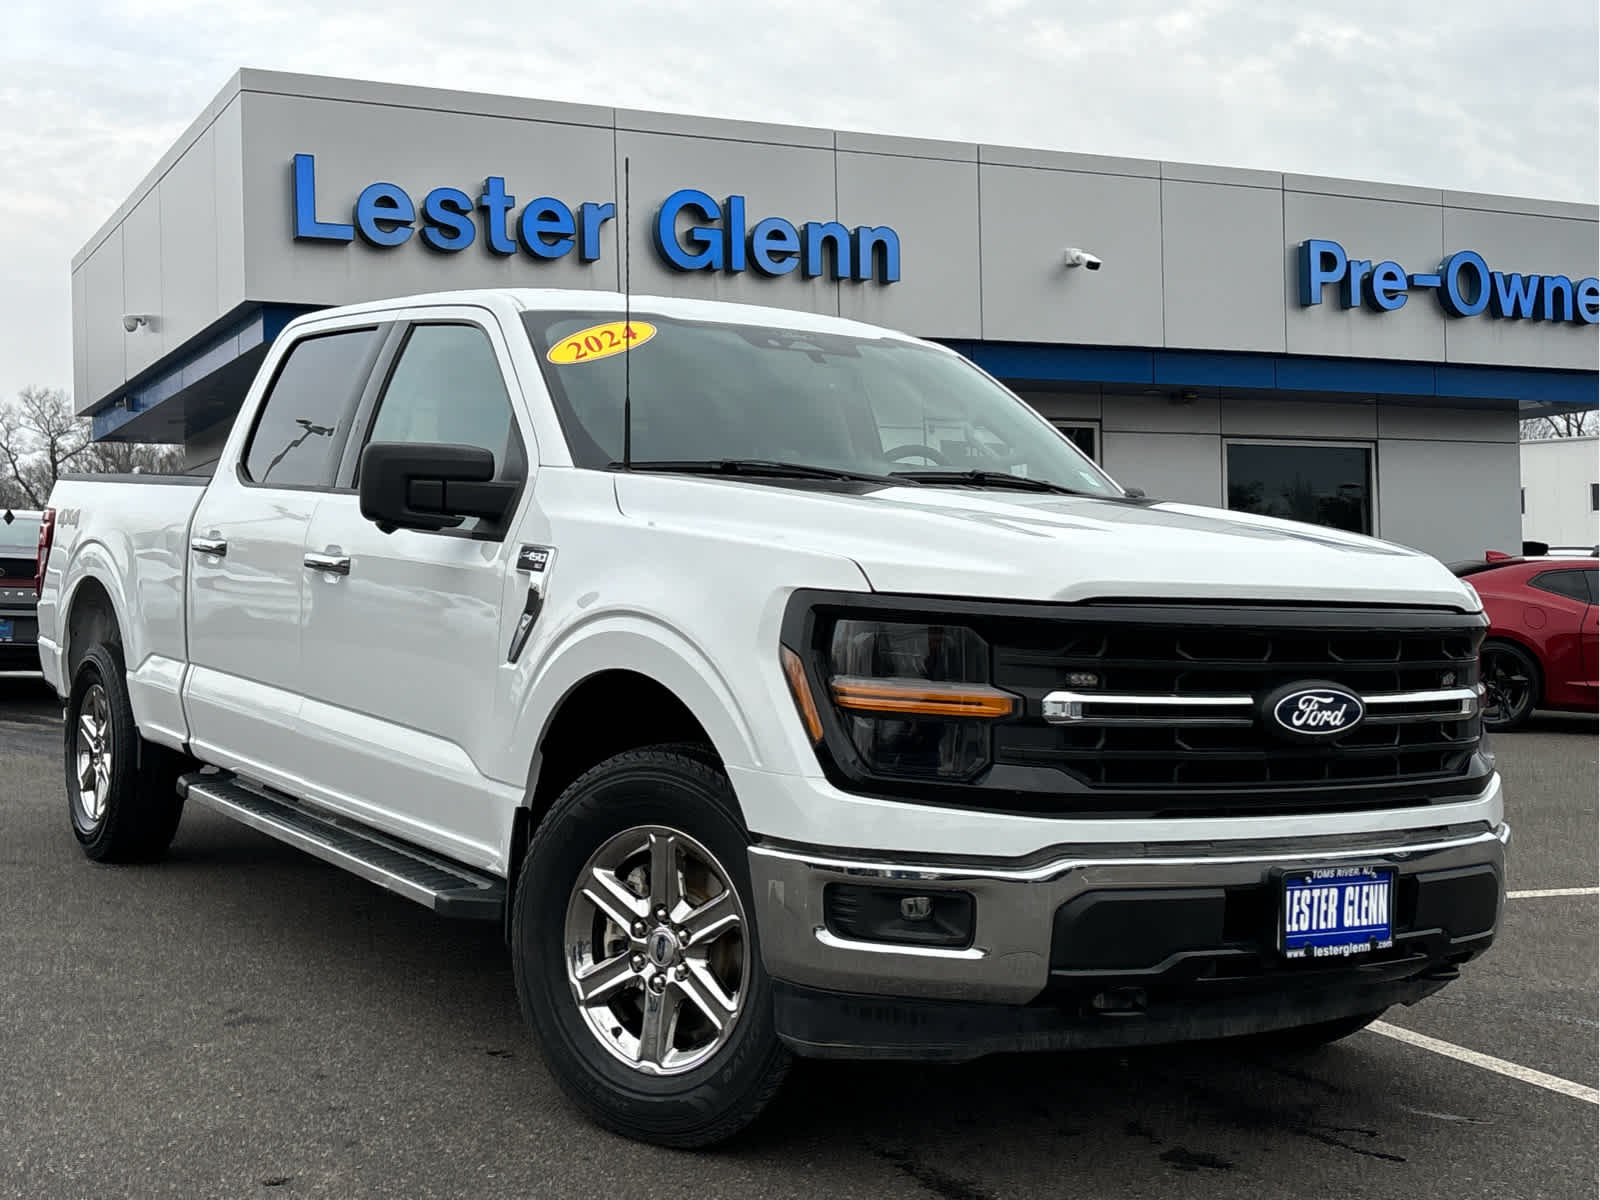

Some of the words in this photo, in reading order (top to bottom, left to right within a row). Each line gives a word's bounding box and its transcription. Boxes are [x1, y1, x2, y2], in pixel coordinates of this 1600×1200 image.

[291, 153, 615, 262] Lester
[653, 188, 900, 284] Glenn
[566, 324, 637, 360] 2024
[1292, 695, 1347, 726] Ford
[1312, 869, 1335, 879] TOMS
[1286, 887, 1338, 932] LESTER
[1343, 883, 1388, 928] GLENN
[1313, 942, 1371, 957] lesterglenn
